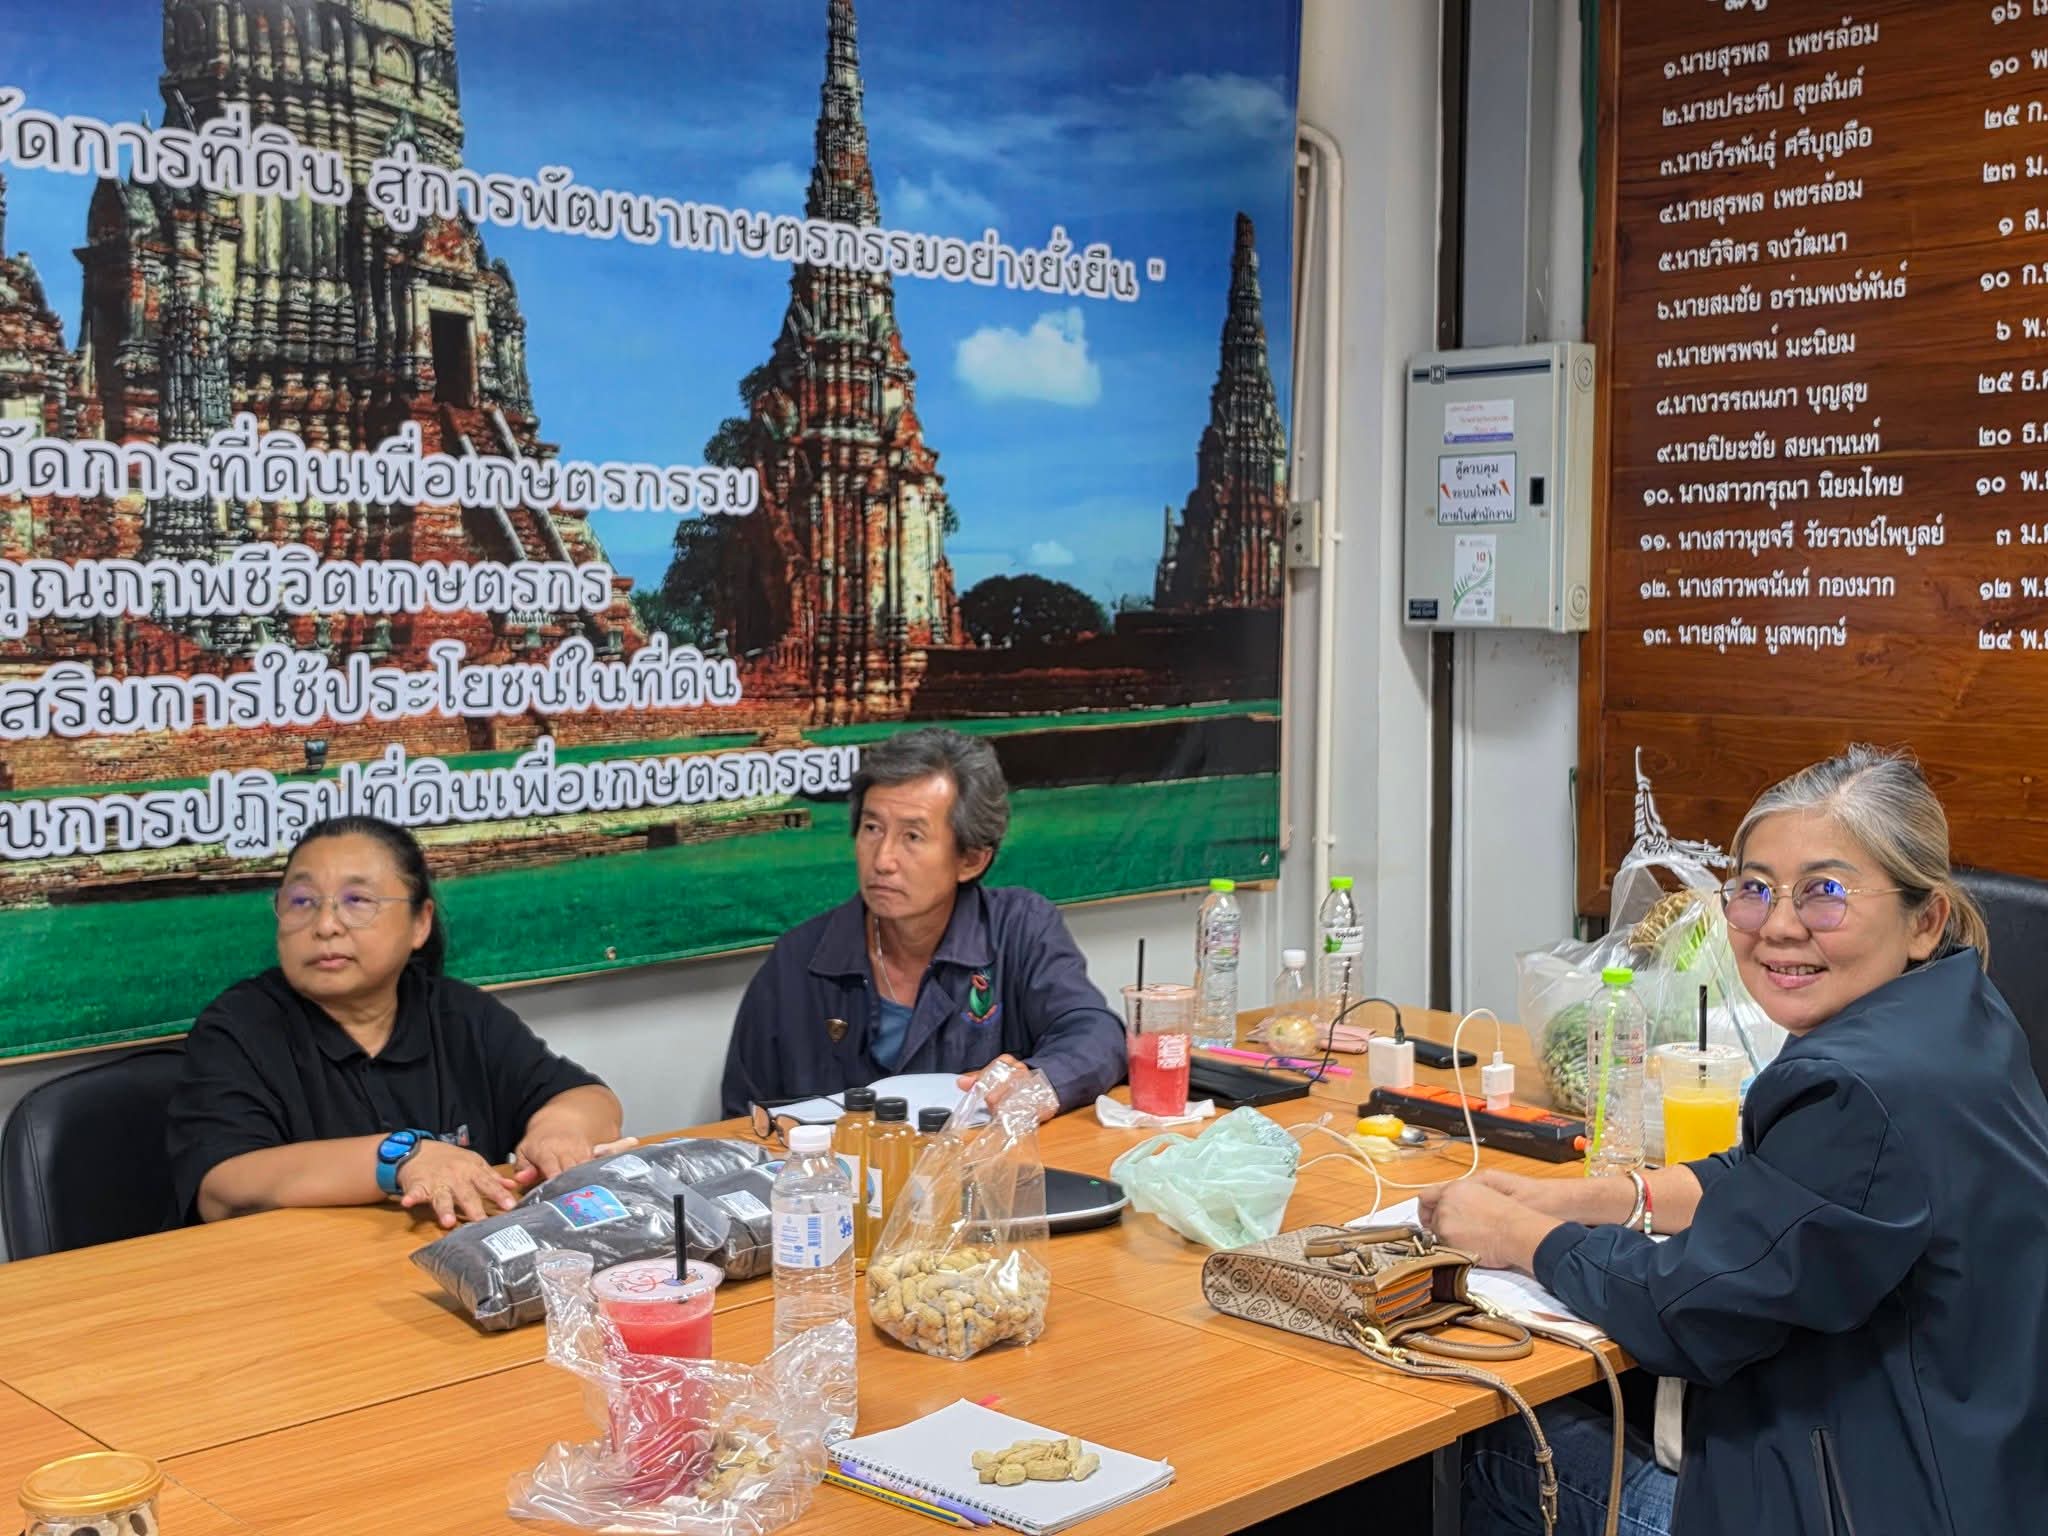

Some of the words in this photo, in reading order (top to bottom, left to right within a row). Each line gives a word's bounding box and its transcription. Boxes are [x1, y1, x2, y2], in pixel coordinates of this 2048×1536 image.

[1663, 41, 1770, 80] ๑.นายสุรพล
[1787, 16, 1880, 57] เพชรล้อม
[1989, 56, 2020, 79] ๑๐
[1662, 80, 1785, 126] ๒.นายประทีป
[1793, 65, 1865, 114] สุขสันต์
[1984, 104, 2021, 129] ๒๕
[1659, 128, 1777, 177] ๓.นายวีรพันธุ์
[1784, 119, 1873, 162] ศรีบุญลือ
[1982, 161, 2017, 184] ๒๓
[0, 89, 346, 201] ัดการที่ดิน
[373, 144, 1137, 298] สู่การพัฒนาเกษตรกรรมอย่างยั่งยืน
[1659, 191, 1764, 225] ๔.นายสุรพล
[1774, 169, 1863, 209] เพชรล้อม
[1998, 217, 2014, 237] ๑
[1658, 237, 1760, 272] ๕.นายวิจิตร
[1767, 226, 1848, 258] จงวัฒนา
[1656, 283, 1761, 319] ๖.นายสมชัย
[1770, 259, 1908, 309] อร่ามพงษ์พันธ์
[1979, 270, 2011, 292] ๑๐
[1656, 323, 1780, 369] ๗.นายพรพจน์
[1785, 327, 1856, 358] มะนิยม
[1996, 319, 2012, 341] ๖
[1656, 386, 1798, 416] ๘.นางวรรณนภา
[1806, 380, 1868, 414] บุญสุข
[1978, 371, 2014, 394] ๒๕
[1656, 431, 1776, 464] ๙.นายปิยะชัย
[1784, 416, 1882, 458] สยนานนท์
[1978, 425, 2012, 447] ๒๐
[2022, 421, 2048, 443] ธ.
[1643, 487, 1674, 507] ๑๐.
[1679, 478, 1808, 510] นางสาวกรุณา
[1818, 465, 1903, 498] นิยมไทย
[1975, 475, 2006, 496] ๑๐
[1639, 532, 1671, 552] ๑๑.
[1678, 520, 1794, 557] นางสาวนุชจรี
[1803, 512, 1945, 556] วัชรวงษ์ไพบูลย์
[1995, 528, 2011, 546] ๓
[1639, 580, 1671, 599] ๑๒.
[1678, 566, 1809, 598] นางสาวพจนันท์
[1818, 575, 1895, 597] กองมาก
[1979, 576, 2012, 600] ๑๒
[1642, 627, 1671, 646] ๑๓.
[1678, 617, 1757, 654] นายสุพัฒ
[1765, 616, 1847, 655] มูลพฤกษ์
